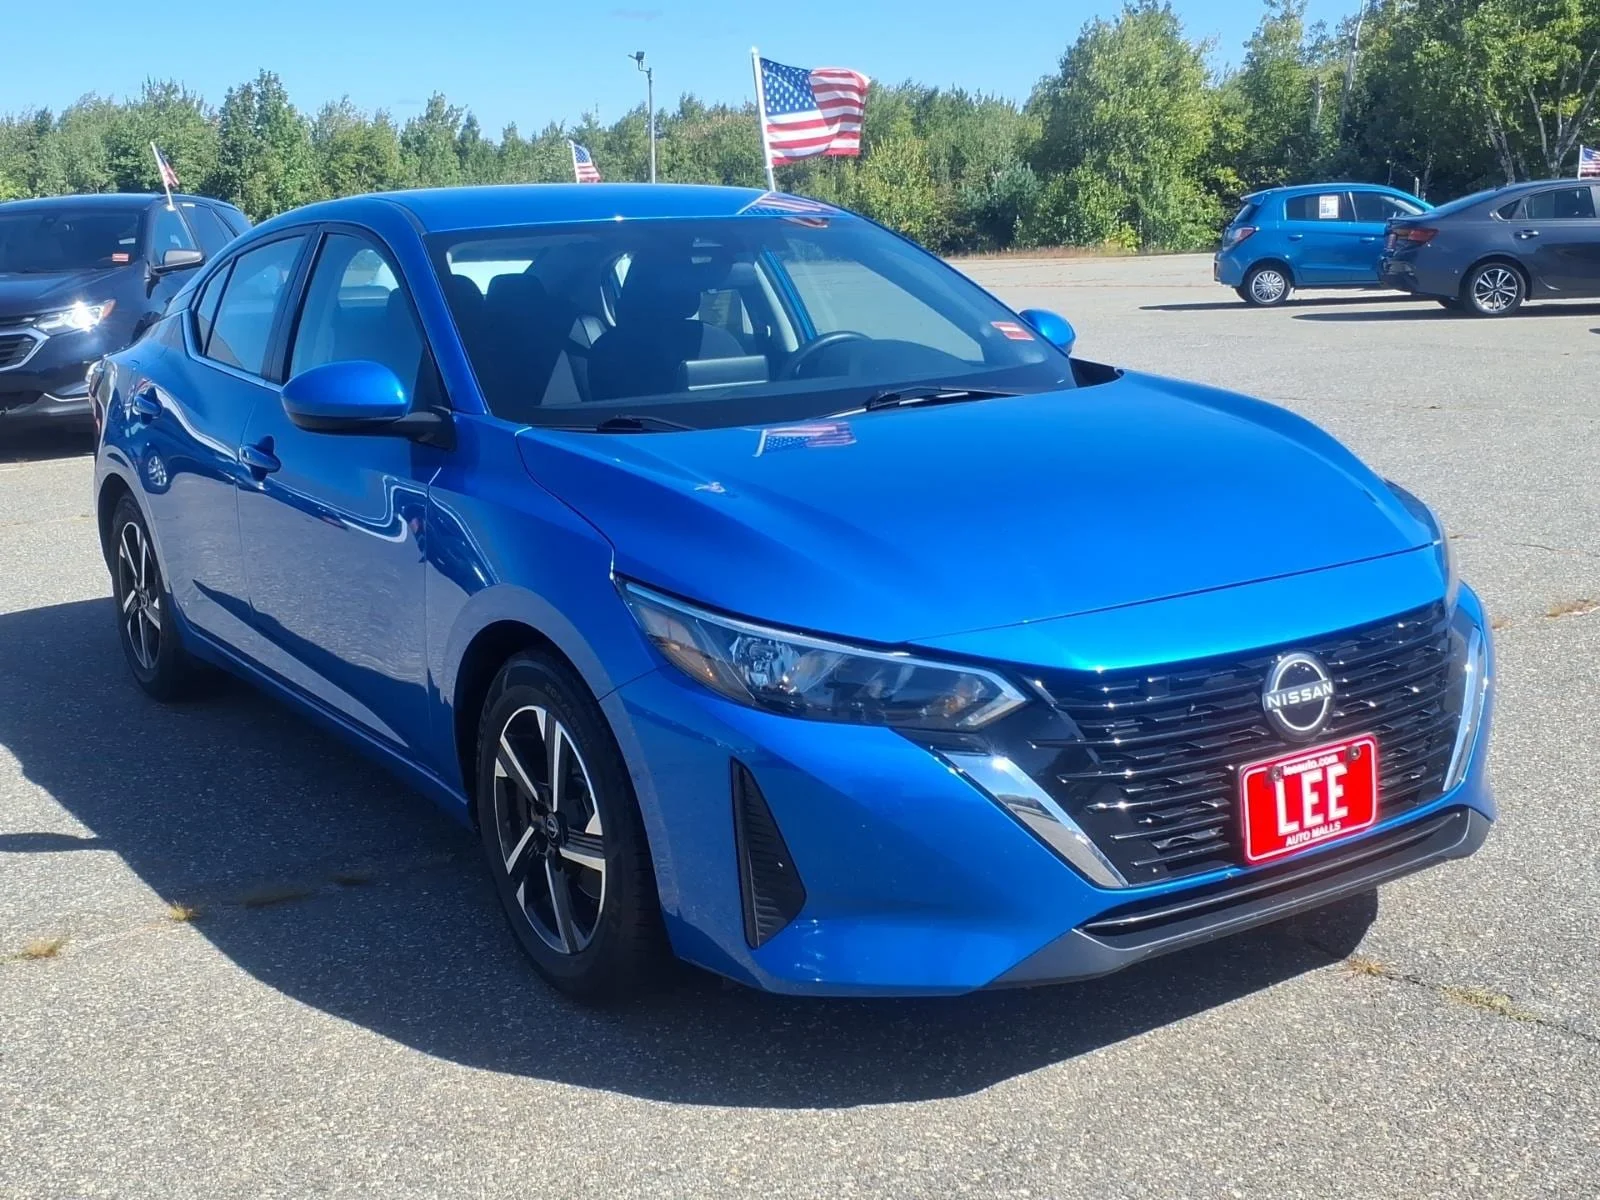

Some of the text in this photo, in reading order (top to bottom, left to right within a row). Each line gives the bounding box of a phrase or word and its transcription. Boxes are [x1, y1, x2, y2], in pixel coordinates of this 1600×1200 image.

[1266, 681, 1334, 708] NISSAN
[1275, 763, 1349, 837] LEE
[1285, 821, 1342, 847] AUTO MALLS
